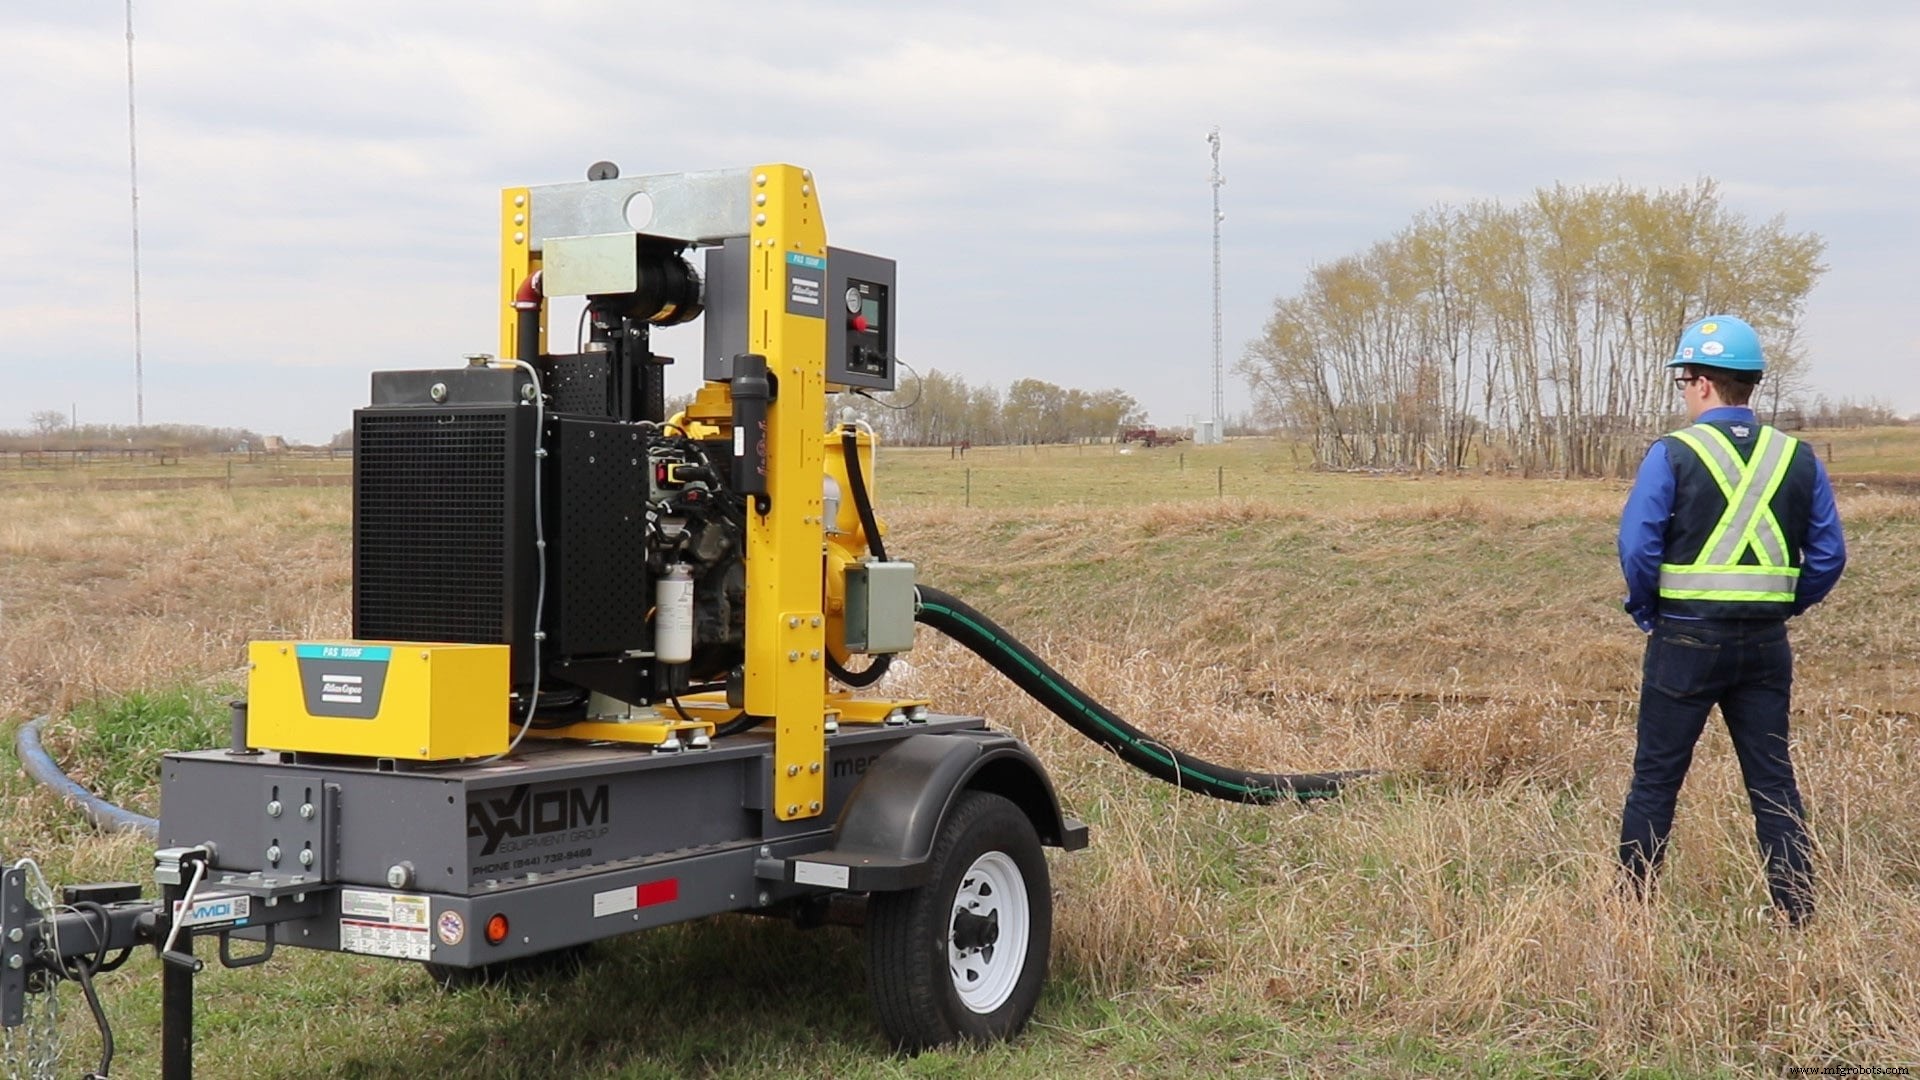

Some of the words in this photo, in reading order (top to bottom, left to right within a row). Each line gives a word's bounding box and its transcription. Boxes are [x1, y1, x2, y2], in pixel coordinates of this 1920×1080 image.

[322, 646, 338, 657] PAS
[341, 647, 362, 657] 100HF
[322, 683, 342, 693] Atlas
[467, 783, 609, 857] AXIOM
[500, 834, 566, 853] EQUIPMENT
[570, 826, 609, 842] GROUP
[472, 861, 510, 875] PHONE
